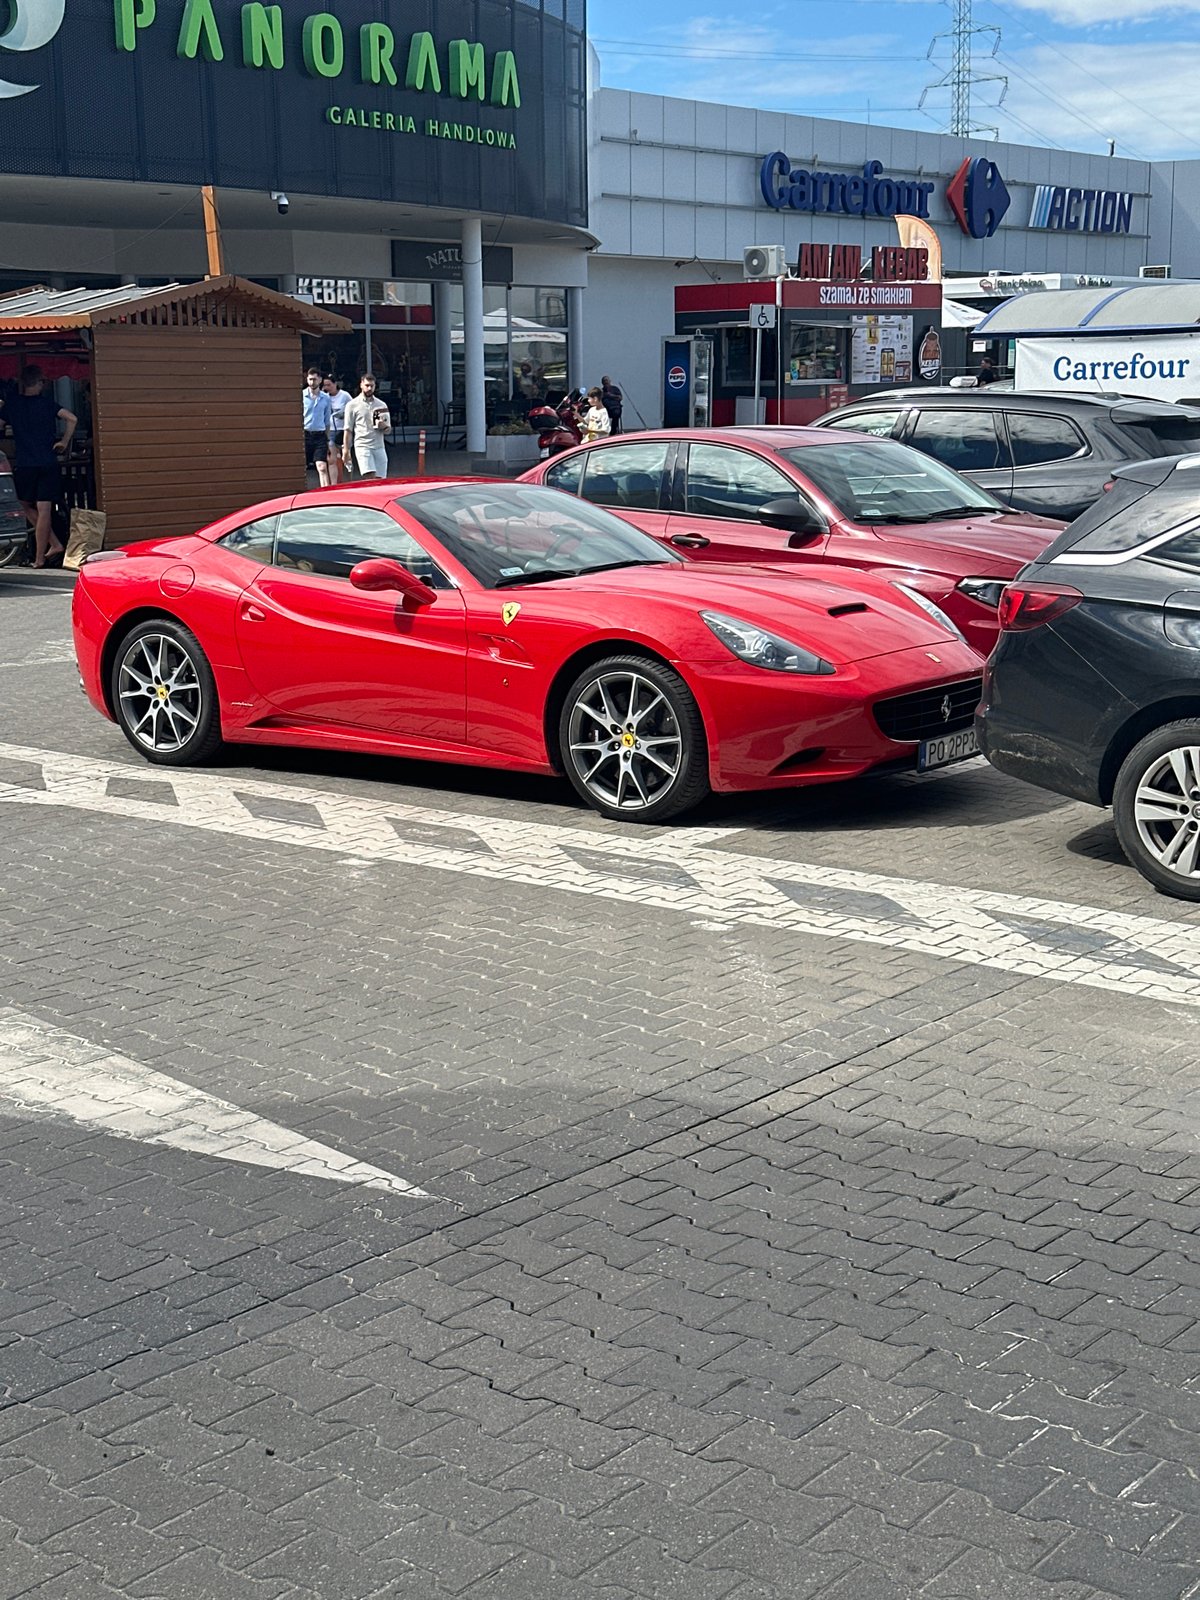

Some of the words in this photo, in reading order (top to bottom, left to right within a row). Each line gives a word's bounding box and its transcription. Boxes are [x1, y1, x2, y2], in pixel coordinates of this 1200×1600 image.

[115, 0, 520, 108] PANORAMA
[328, 106, 416, 134] GALERIA
[427, 119, 517, 150] HANDLOWA
[760, 151, 934, 218] Carrefour
[1050, 187, 1133, 234] ACTION
[799, 243, 829, 279] AM
[831, 244, 861, 279] AM
[872, 246, 928, 280] KEBAB
[298, 278, 361, 304] KEBAB
[1053, 352, 1190, 381] Carrefour
[928, 741, 945, 764] PO
